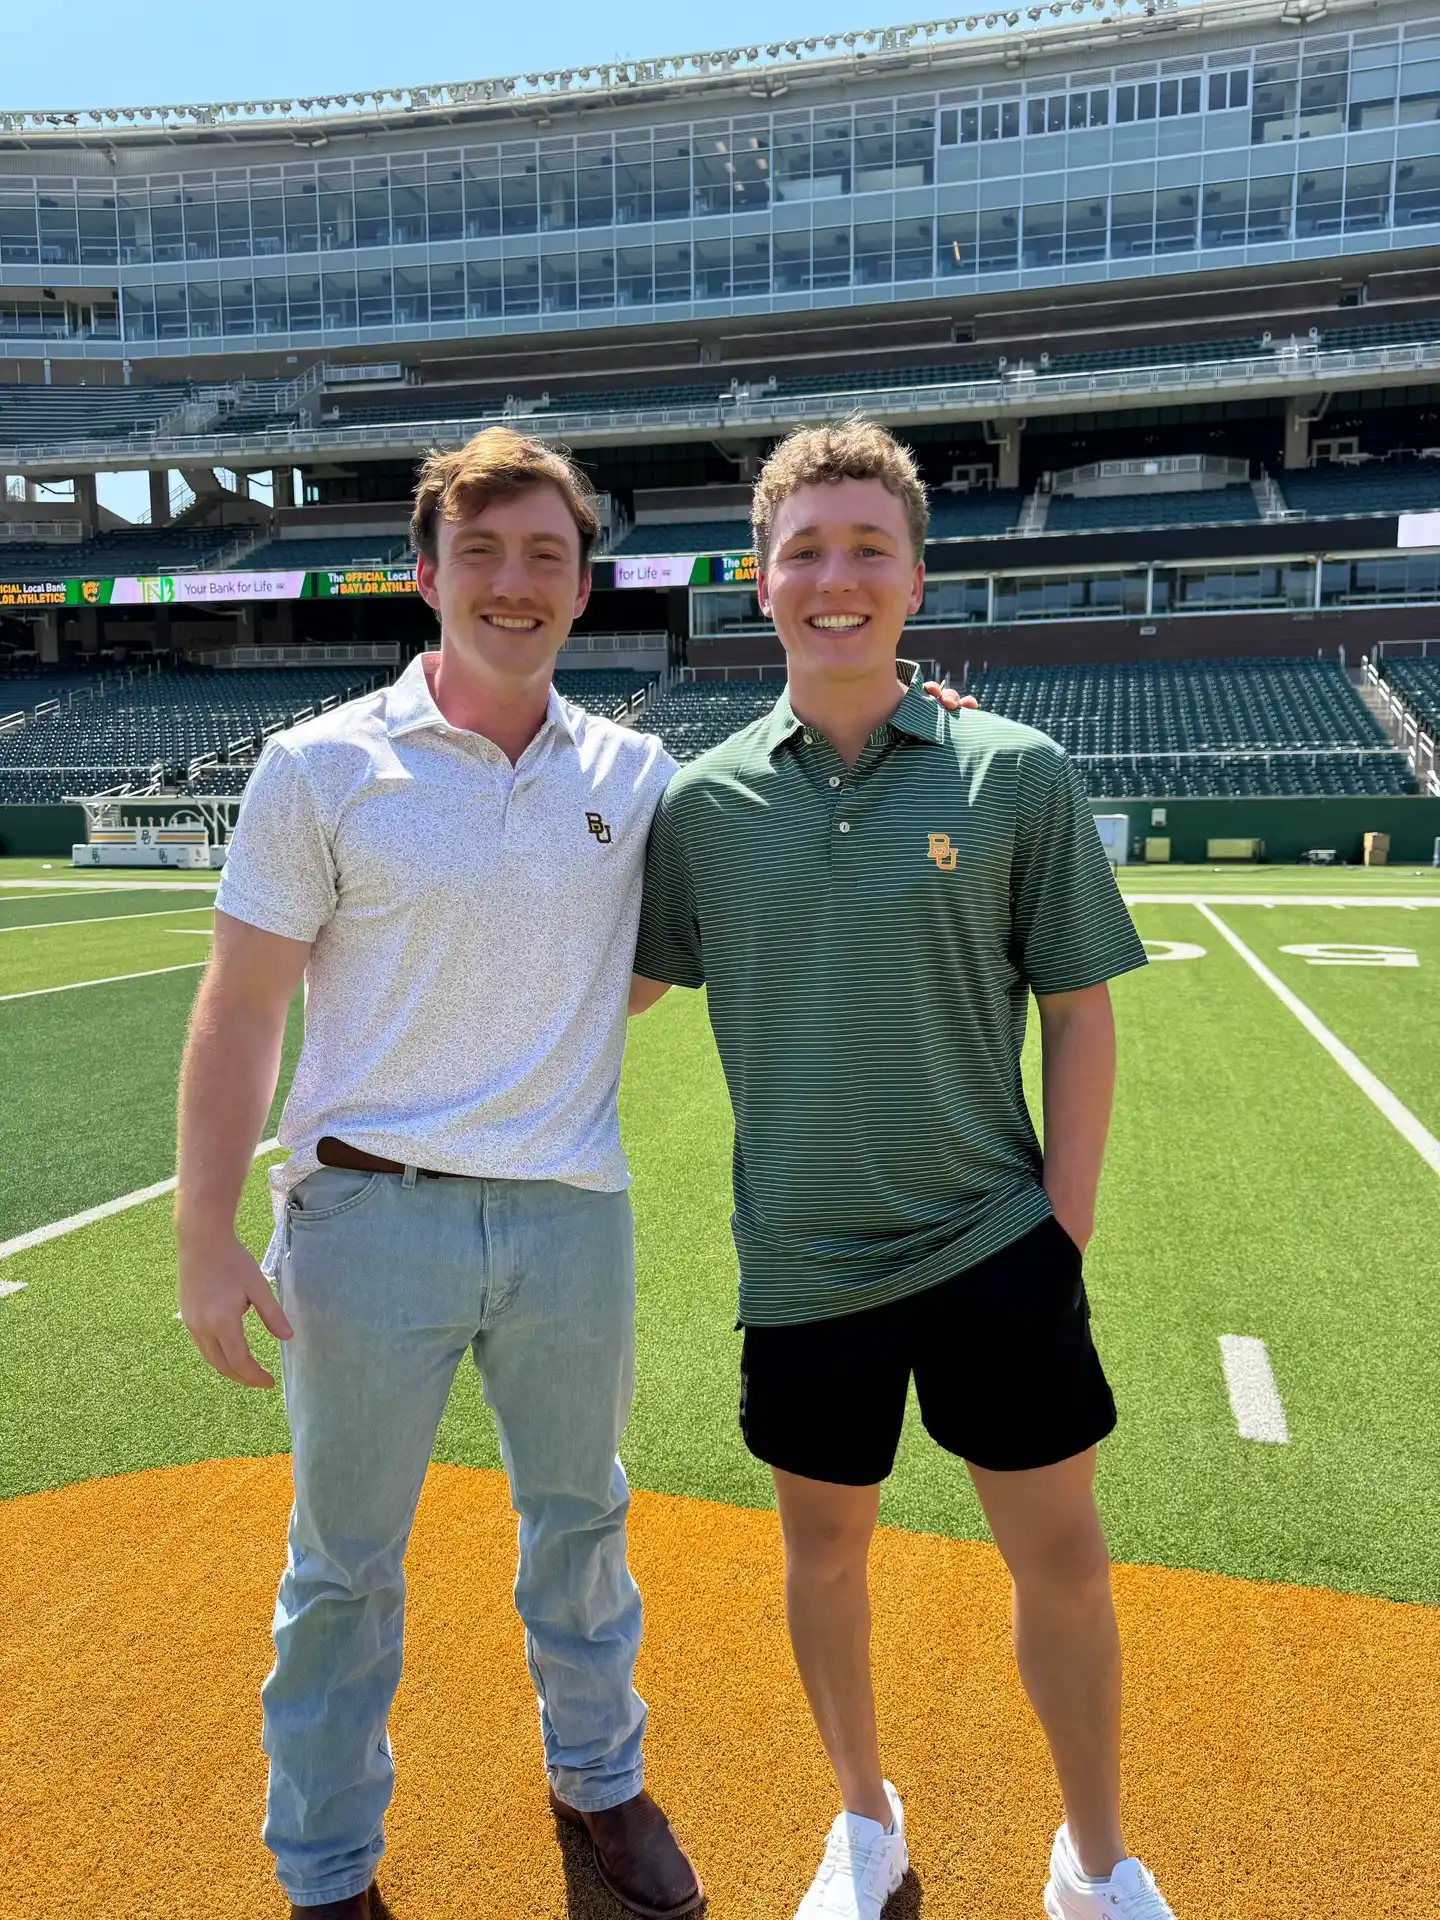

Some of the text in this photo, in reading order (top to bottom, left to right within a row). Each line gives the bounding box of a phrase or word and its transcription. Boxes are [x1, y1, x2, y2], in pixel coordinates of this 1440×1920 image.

[722, 557, 740, 568] The
[328, 573, 344, 583] The
[345, 571, 386, 582] OFFICIAL
[387, 570, 411, 581] Local
[619, 568, 634, 581] for
[637, 567, 657, 580] Life
[724, 567, 756, 580] of BAY
[23, 583, 45, 593] Local
[46, 582, 67, 593] Bank
[185, 583, 206, 595] Your
[209, 581, 235, 594] Bank
[237, 580, 251, 593] for
[254, 579, 272, 592] Life
[330, 581, 418, 594] of BAYLOR ATHLET
[17, 593, 66, 604] ATHLETICS
[585, 812, 613, 844] BU
[927, 833, 958, 871] BU
